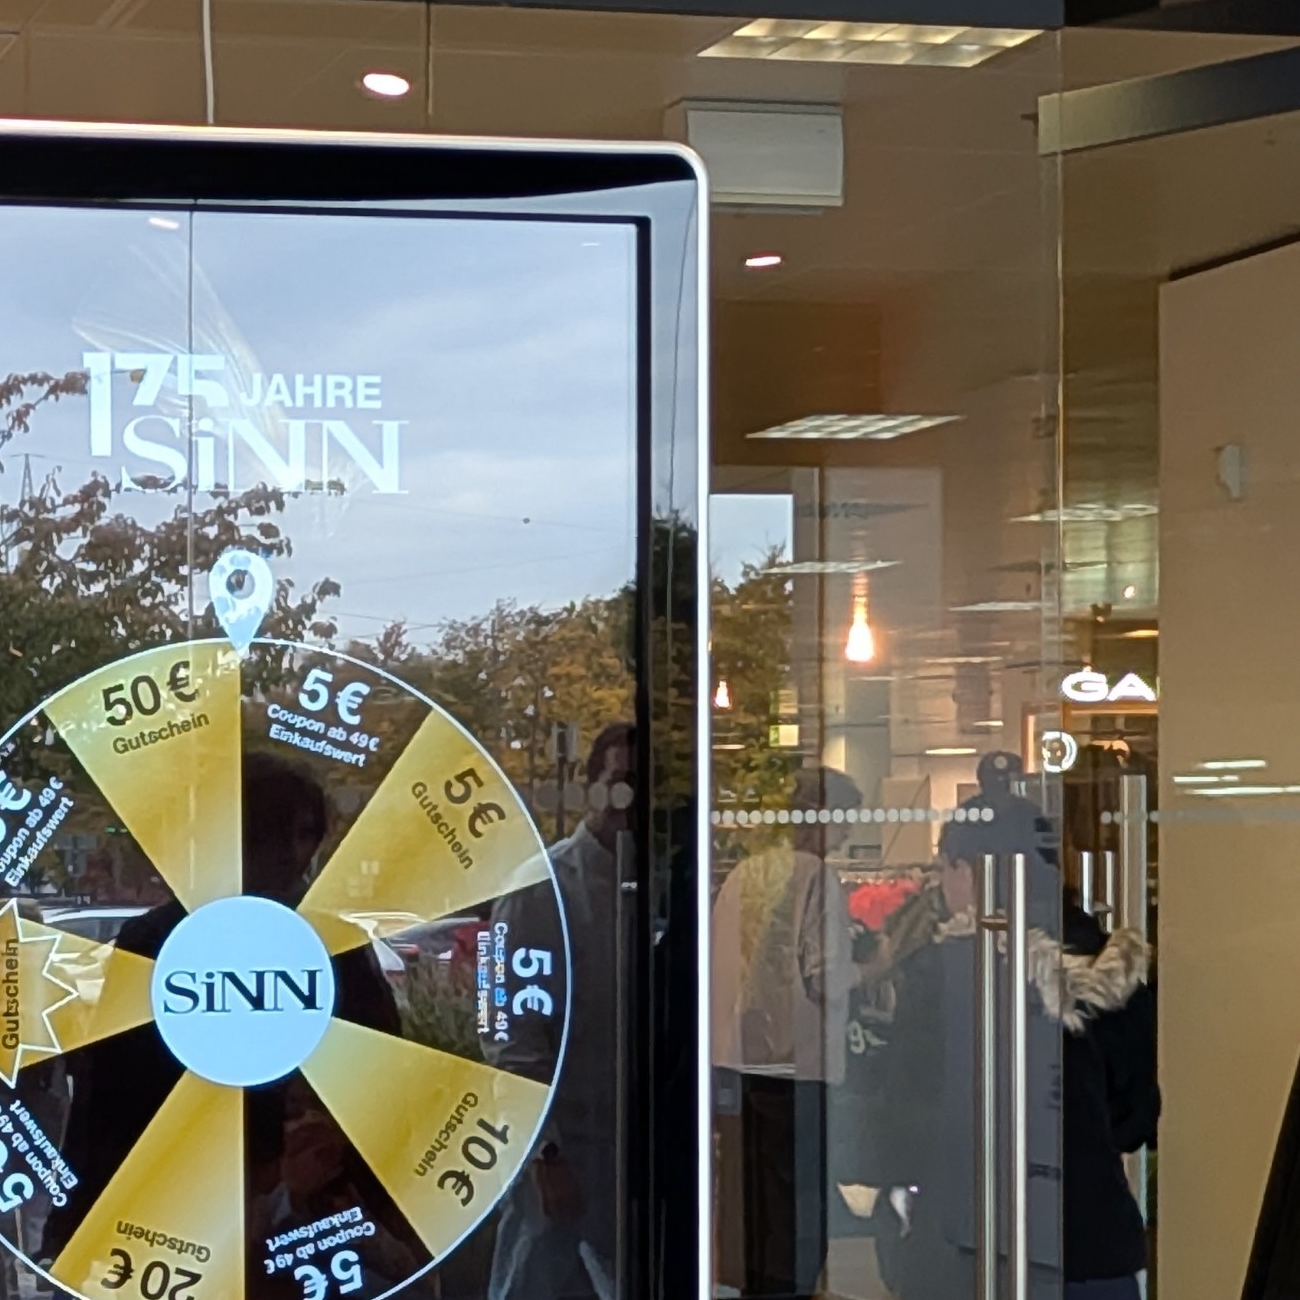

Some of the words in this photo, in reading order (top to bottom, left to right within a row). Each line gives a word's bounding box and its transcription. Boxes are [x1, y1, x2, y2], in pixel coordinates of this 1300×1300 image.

[83, 352, 230, 457] 175
[240, 373, 382, 409] JAHRE
[1062, 671, 1160, 702] GA
[112, 711, 210, 755] Gutschein
[267, 703, 326, 735] Coupon
[327, 724, 347, 742] ab
[269, 724, 367, 768] Einkaufswert
[25, 808, 43, 828] ab
[411, 781, 474, 870] Gutschein
[4, 797, 74, 887] Einkaufswert
[1, 938, 20, 1050] Gutschein
[9, 1099, 79, 1190] Einkaufswert
[11, 1132, 30, 1152] ab
[414, 1091, 479, 1177] Gutschein
[25, 1151, 67, 1207] Coupon
[116, 1220, 211, 1264] Gutschein
[265, 1206, 363, 1251] Einkaufswert
[318, 1221, 377, 1251] Coupon
[296, 1242, 316, 1260] ab
